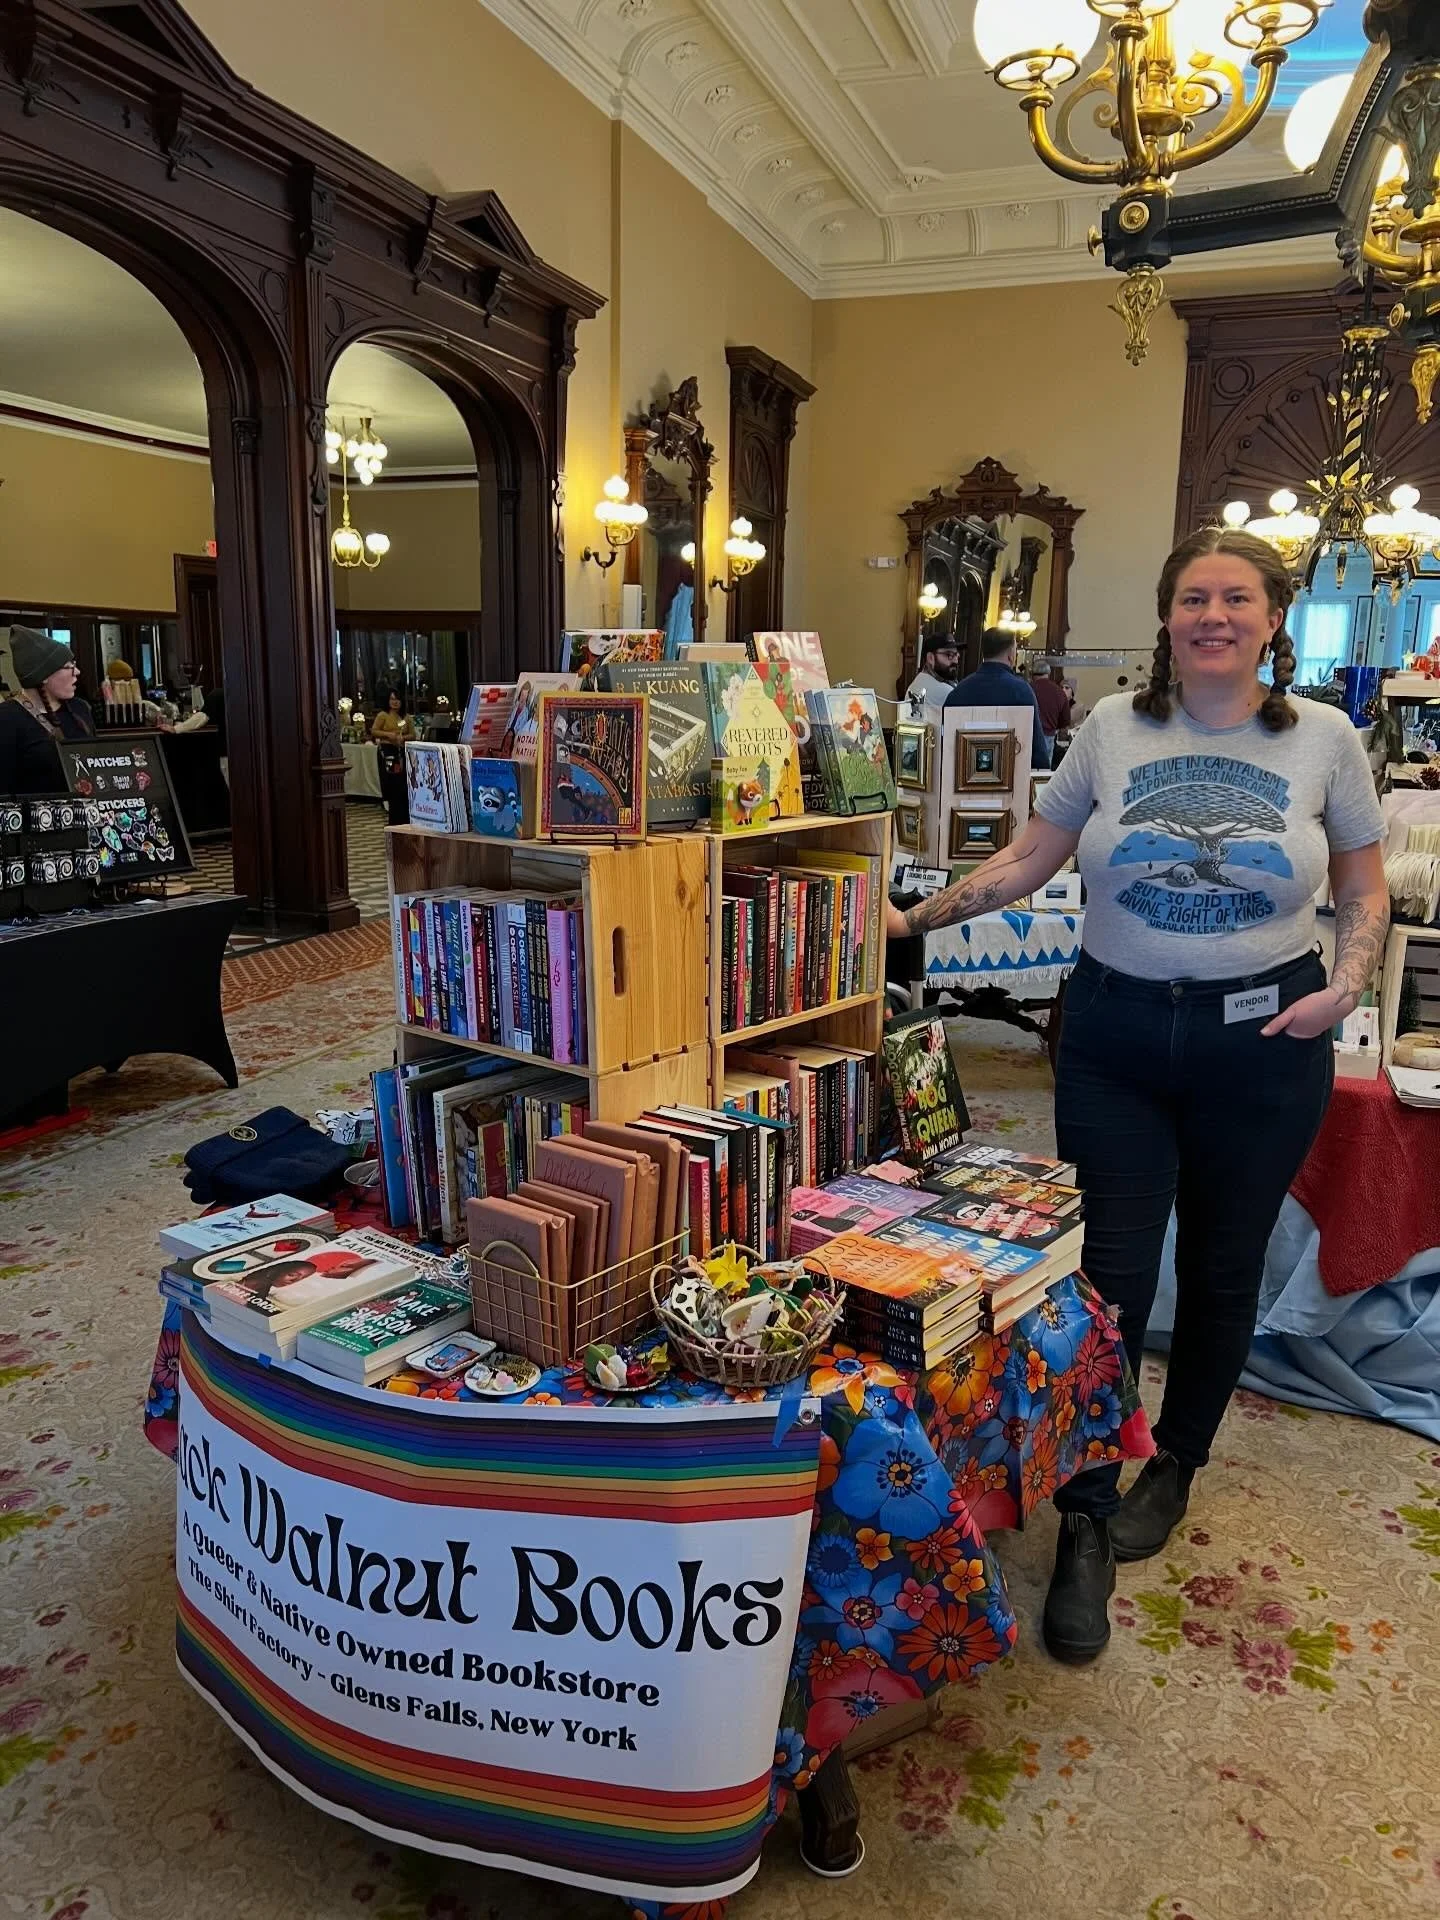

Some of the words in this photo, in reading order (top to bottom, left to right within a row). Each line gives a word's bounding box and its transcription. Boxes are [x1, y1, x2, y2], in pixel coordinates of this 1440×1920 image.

[760, 632, 817, 661] ONE
[646, 680, 700, 695] KUANG
[517, 736, 538, 744] NOTAB
[728, 727, 788, 742] REVERED
[516, 748, 537, 757] NATIVE
[738, 742, 782, 757] ROOTS
[87, 756, 132, 768] PATCHES
[1130, 767, 1151, 784] WE
[1154, 757, 1185, 777] LIVE
[1186, 757, 1201, 770] IN
[648, 783, 712, 799] ATABASIS
[1124, 784, 1144, 802] ITS
[1146, 771, 1184, 794] POWER
[1186, 770, 1219, 783] SEEMS
[1220, 771, 1289, 809] INESCAPABLE
[98, 798, 146, 811] STICKERS
[872, 862, 881, 899] OLD
[1131, 880, 1160, 900] BUT
[1165, 890, 1184, 904] SO
[1193, 893, 1223, 907] DID
[1230, 890, 1262, 905] THE
[1118, 891, 1164, 919] DIVINE
[1167, 904, 1210, 925] RIGHT
[1215, 908, 1230, 924] OF
[1234, 901, 1274, 921] KINGS
[871, 903, 880, 954] SOUL
[1150, 920, 1184, 933] URSULA
[1233, 995, 1270, 1009] VENDOR
[916, 1104, 958, 1143] QUEEN
[922, 1143, 939, 1161] ANNA
[890, 1221, 926, 1236] THE
[336, 1239, 376, 1256] ZAMI
[821, 1238, 859, 1263] GOD
[829, 1242, 882, 1271] SAVE
[248, 1293, 281, 1313] LORDE
[390, 1295, 441, 1317] MAKE
[330, 1316, 395, 1342] BRIGHT
[351, 1307, 417, 1335] SEASON
[179, 1424, 229, 1523] ack
[239, 1463, 480, 1626] Walnut
[511, 1546, 784, 1653] Books
[183, 1510, 191, 1536] A
[192, 1521, 245, 1581] Queer
[246, 1571, 258, 1595] &
[260, 1581, 332, 1647] Native
[336, 1621, 454, 1679] Owned
[462, 1652, 661, 1708] Bookstore
[188, 1554, 212, 1596] The
[213, 1577, 249, 1630] Shirt
[249, 1612, 314, 1683] Factory
[330, 1673, 402, 1713] Glens
[406, 1696, 485, 1731] Falls,
[490, 1709, 556, 1739] New
[560, 1717, 638, 1753] York
